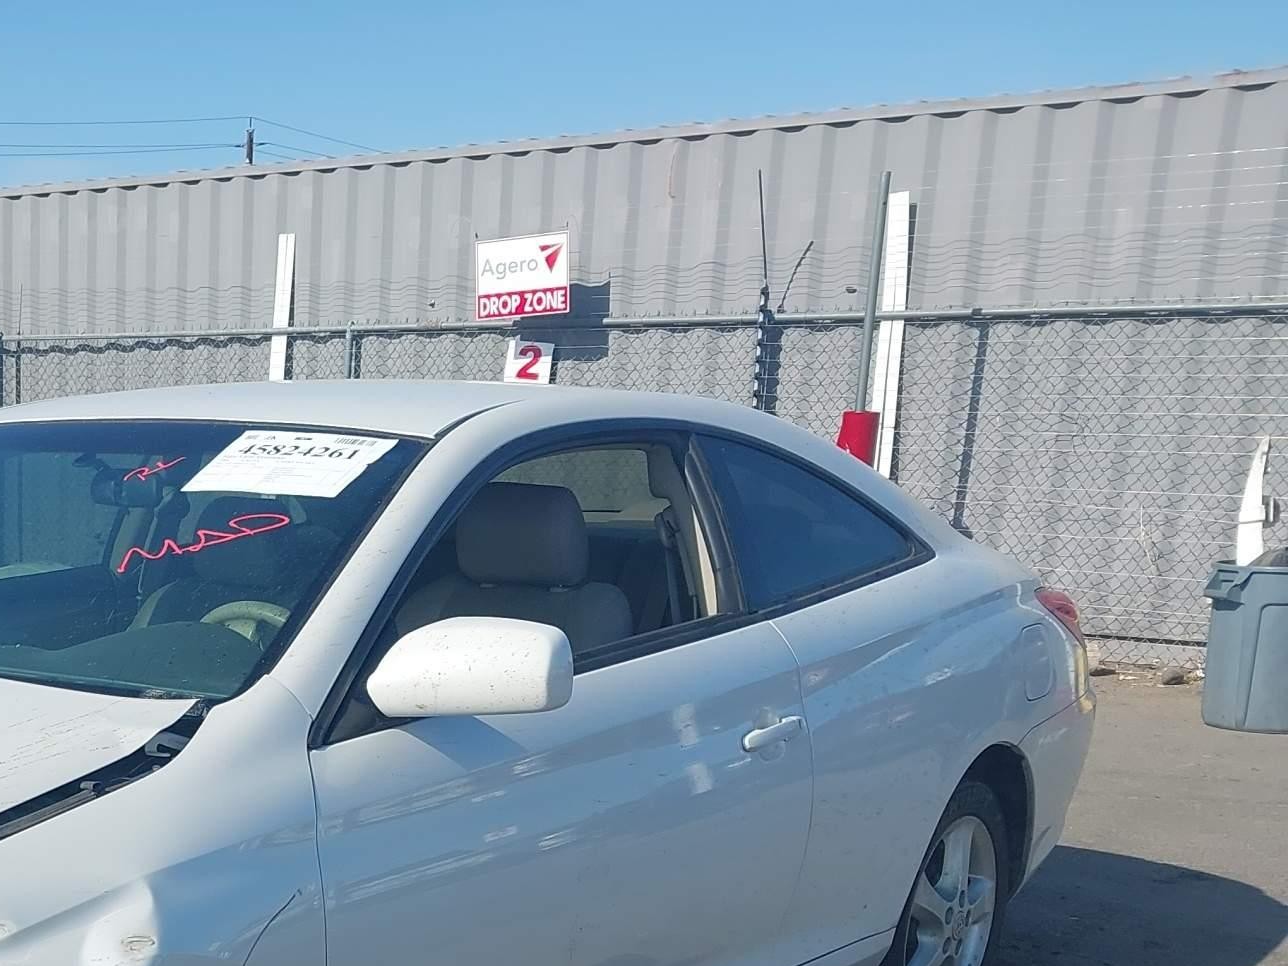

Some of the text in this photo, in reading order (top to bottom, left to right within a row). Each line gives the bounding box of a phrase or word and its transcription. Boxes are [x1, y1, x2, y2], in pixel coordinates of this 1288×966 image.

[481, 257, 539, 280] Agero
[480, 288, 566, 317] DROP ZONE
[515, 344, 543, 381] 2
[238, 443, 361, 460] 45824261
